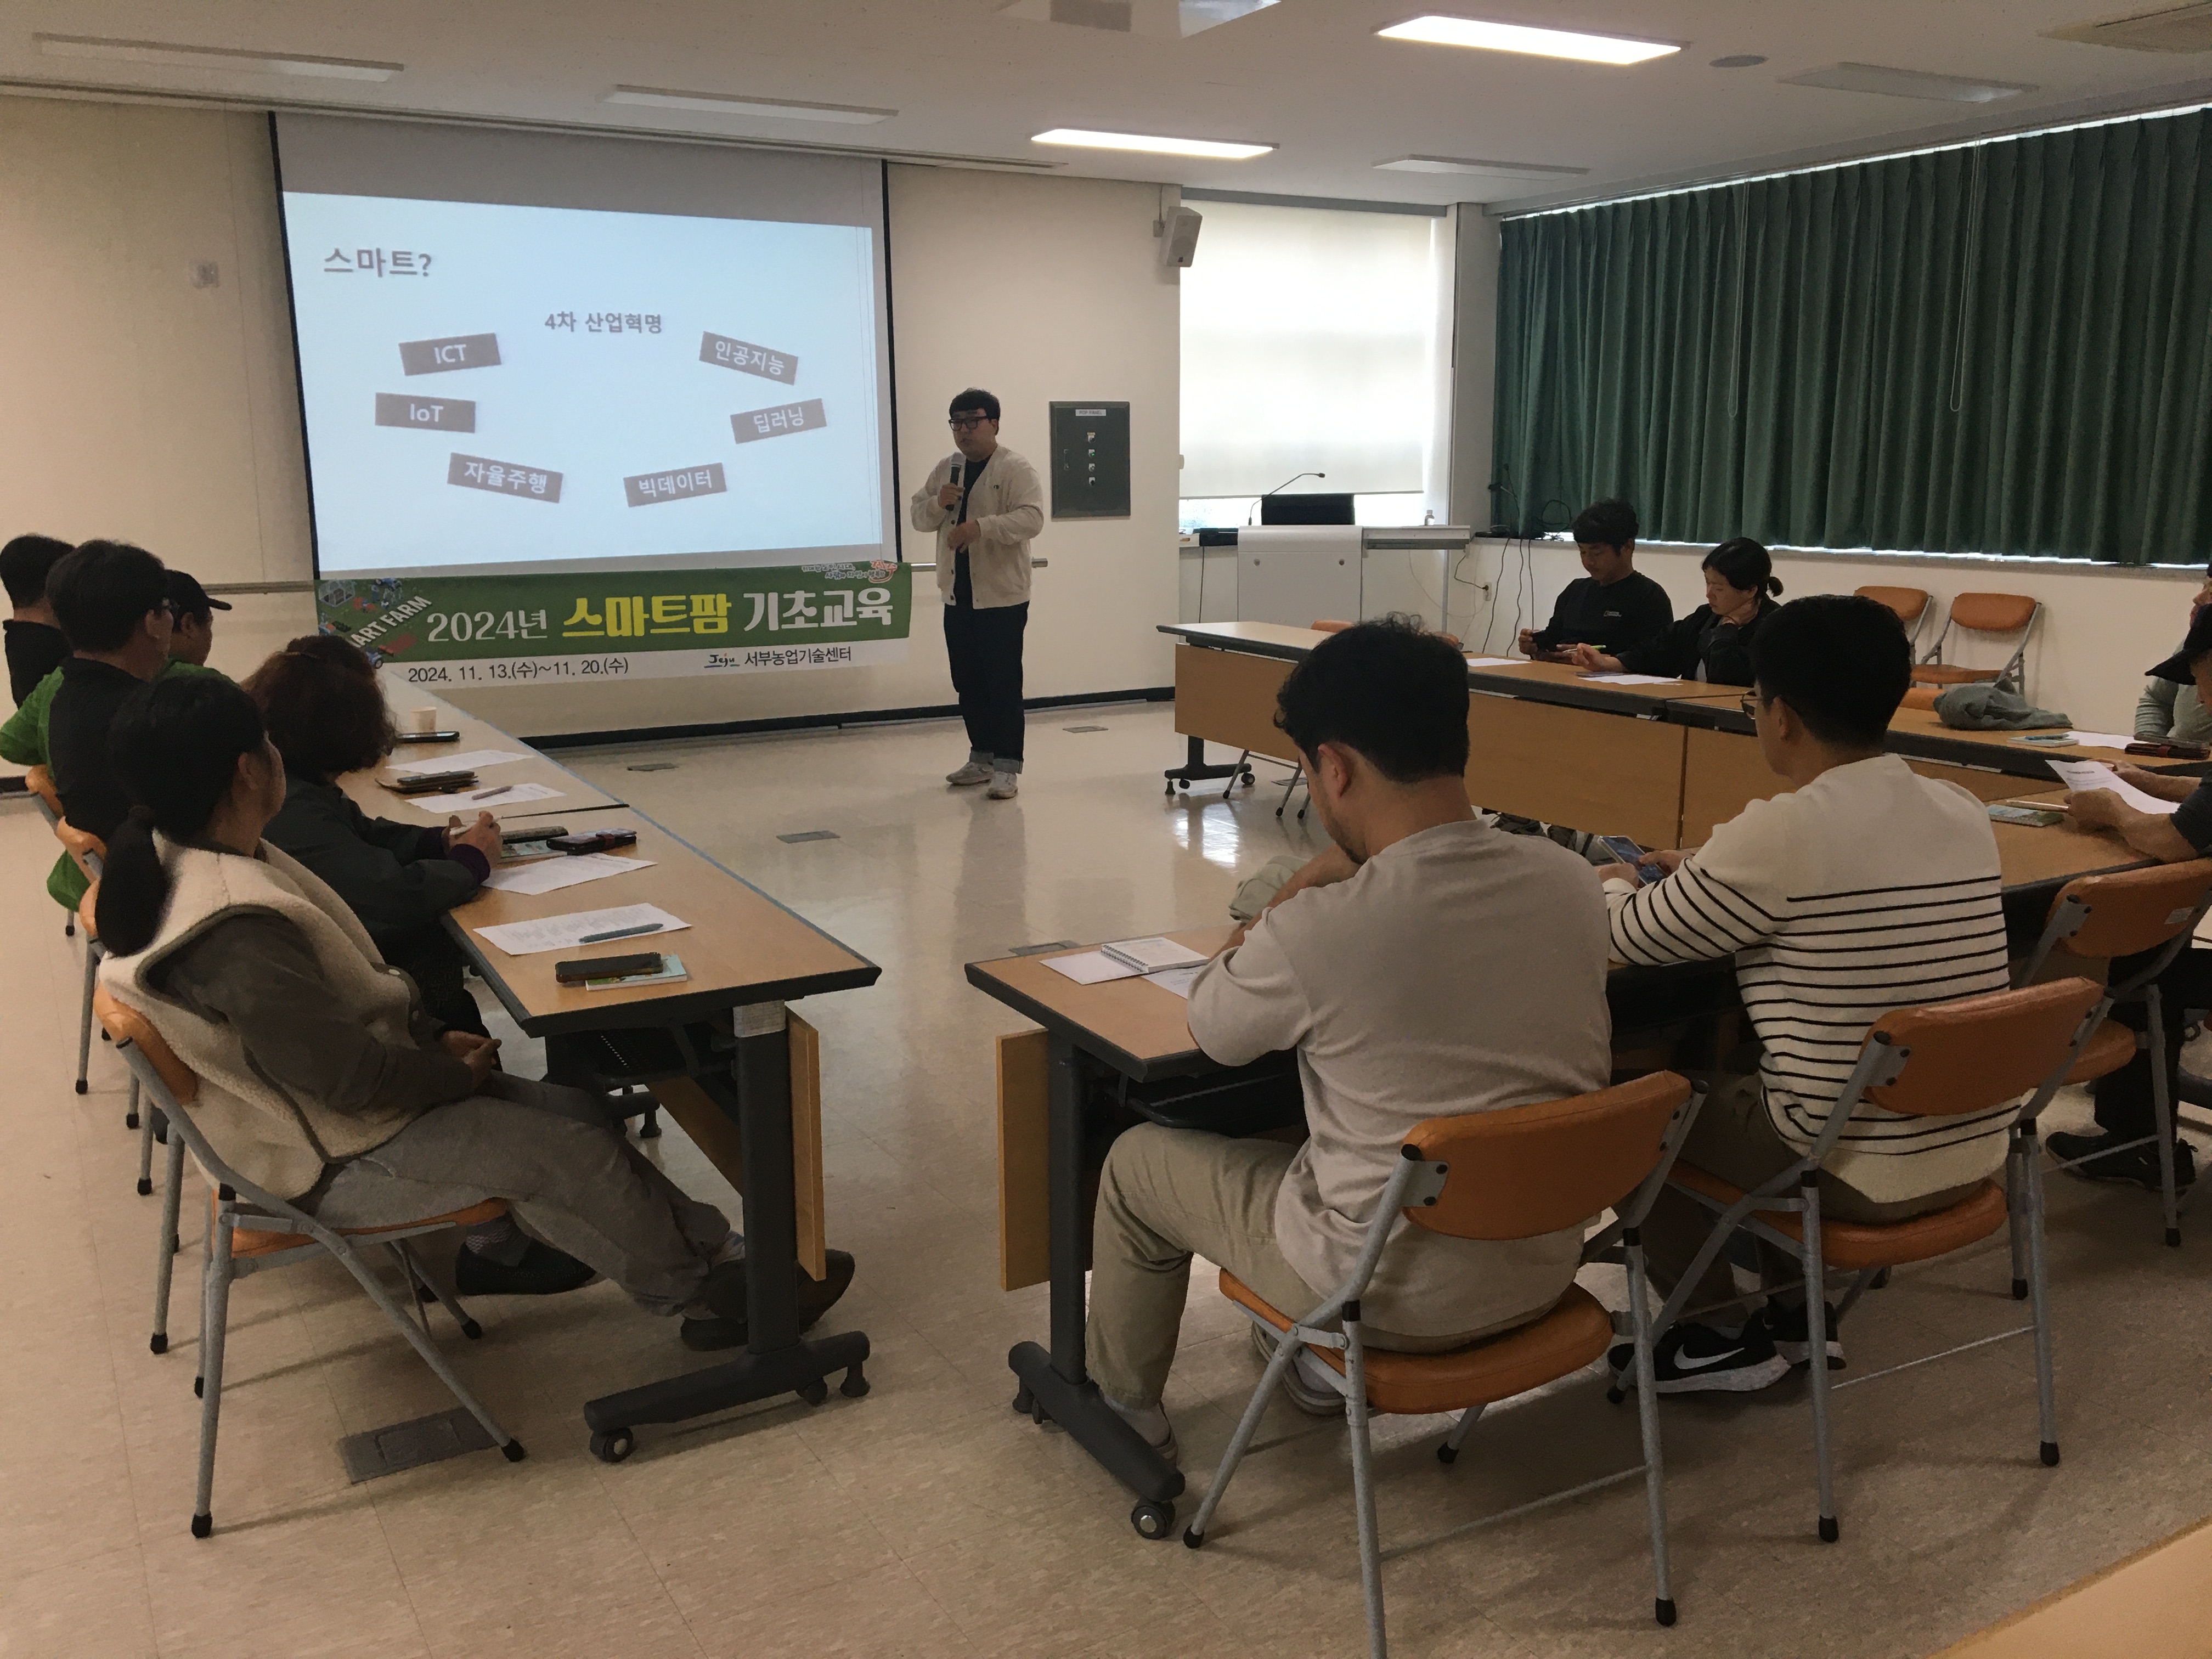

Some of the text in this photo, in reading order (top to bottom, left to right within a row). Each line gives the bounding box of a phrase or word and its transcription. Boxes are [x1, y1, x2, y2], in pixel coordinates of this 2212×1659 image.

[324, 247, 431, 279] 스마트?
[545, 311, 663, 334] 4차 산업혁명
[435, 343, 467, 365] ICT
[714, 340, 786, 376] 인공지능
[409, 404, 444, 424] IoT
[753, 405, 805, 434] 딥러닝
[464, 461, 548, 495] 자율주행
[638, 470, 713, 498] 빅데이터
[350, 596, 432, 648] ART FARM
[427, 587, 894, 642] 2024년 스마트팜 기초교육
[408, 667, 452, 682] 2024.
[459, 666, 482, 680] 11.
[581, 657, 629, 675] 20.(수)
[708, 653, 735, 668] Jeju
[744, 646, 851, 666] 서부농업기술센터
